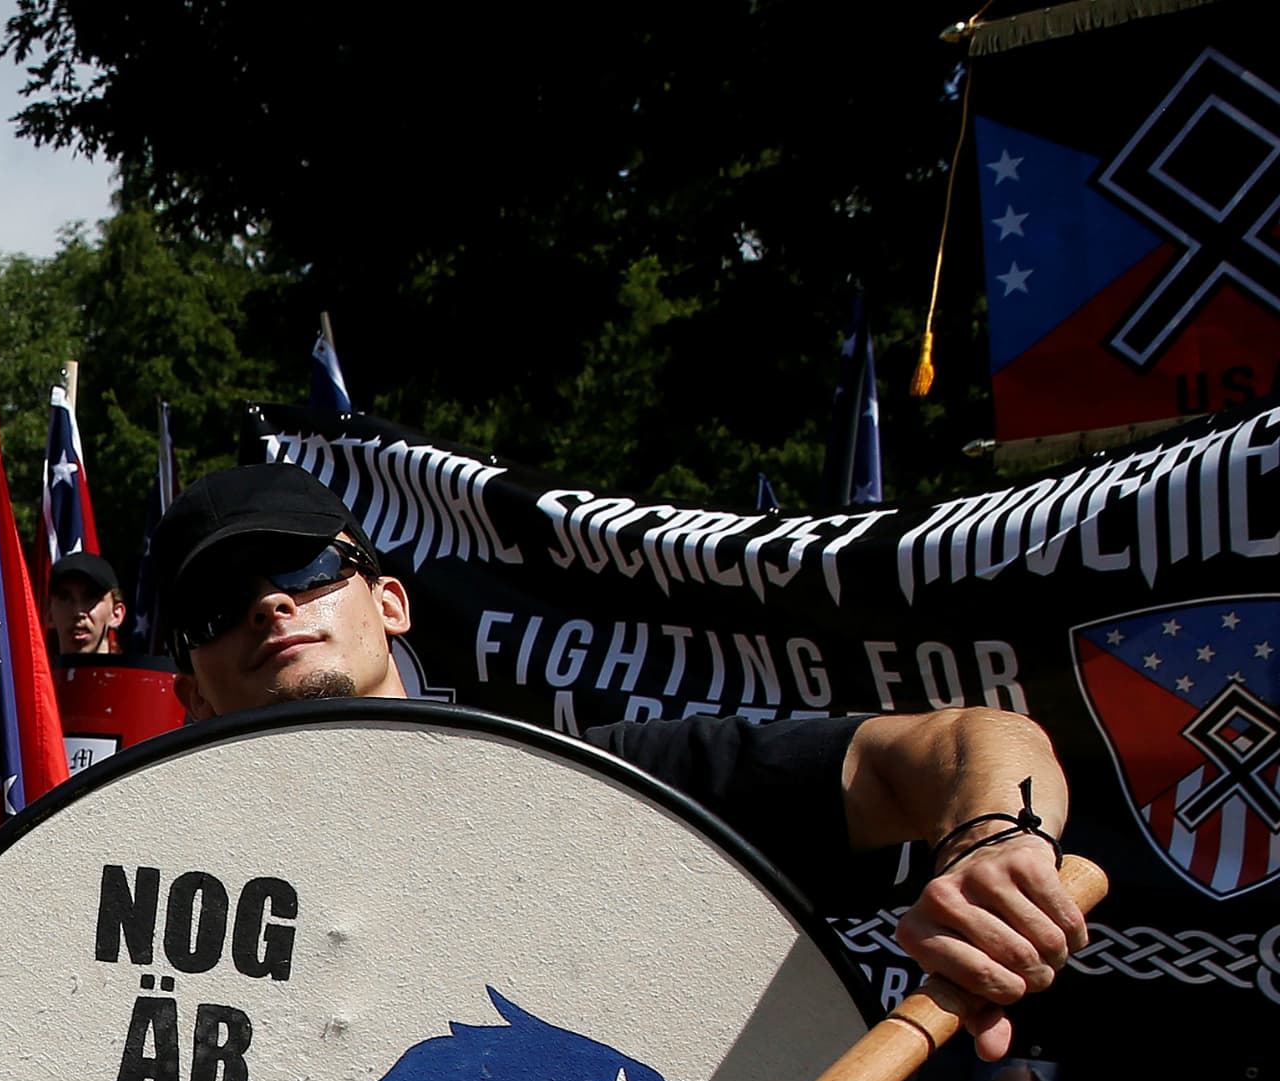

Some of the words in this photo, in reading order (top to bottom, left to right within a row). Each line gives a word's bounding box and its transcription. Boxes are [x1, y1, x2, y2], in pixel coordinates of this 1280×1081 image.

[1176, 363, 1280, 415] US
[537, 490, 898, 607] SOCIALIST
[476, 610, 832, 708] FIGHTING
[863, 640, 1029, 716] FOR
[95, 865, 299, 981] NOG
